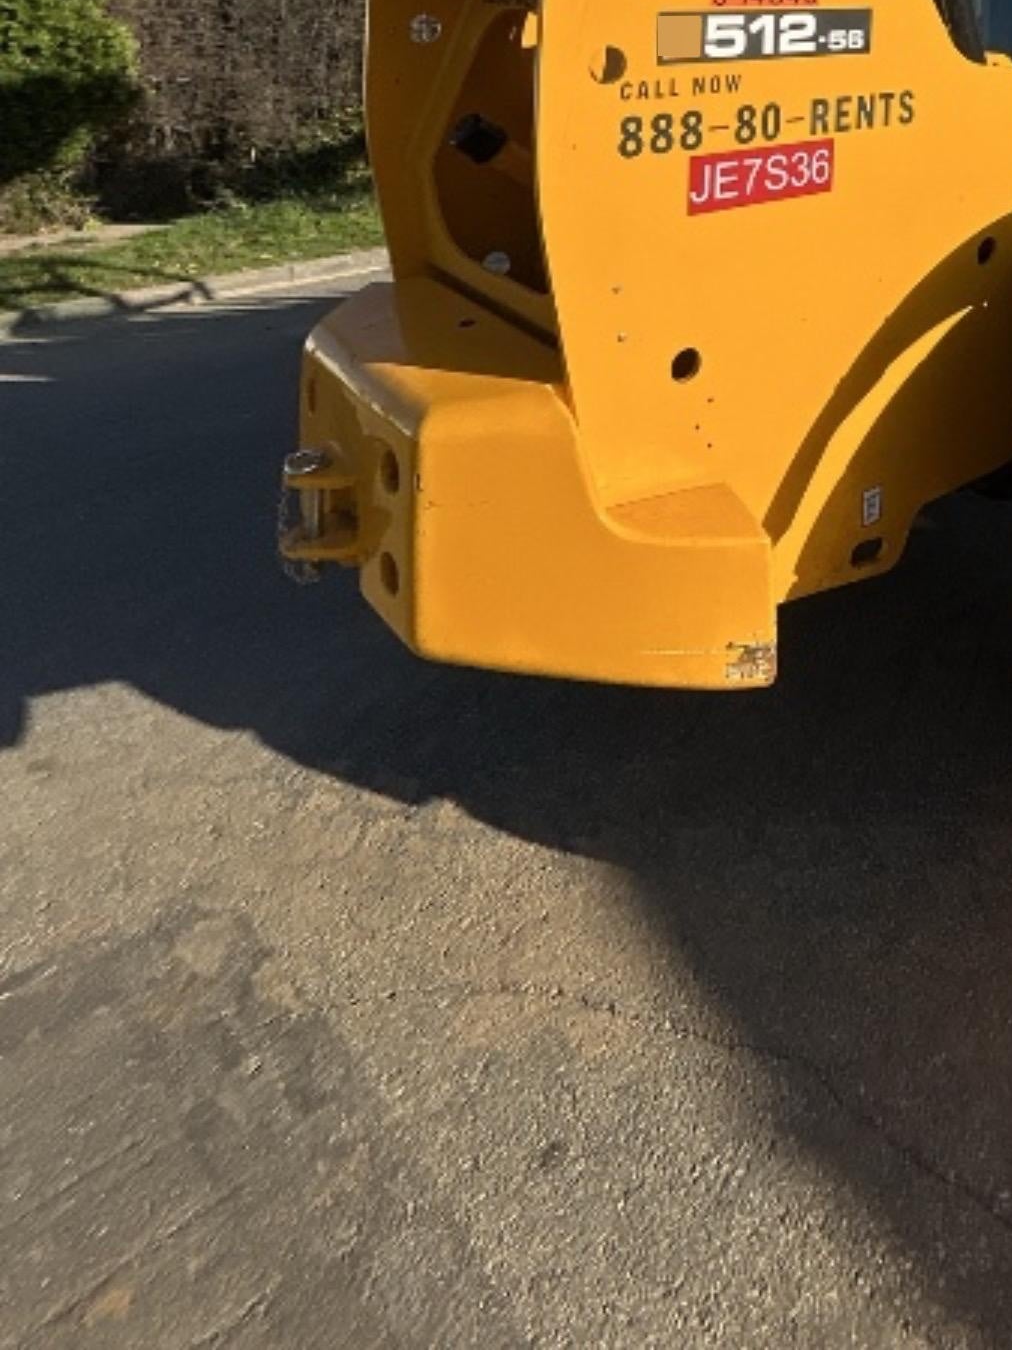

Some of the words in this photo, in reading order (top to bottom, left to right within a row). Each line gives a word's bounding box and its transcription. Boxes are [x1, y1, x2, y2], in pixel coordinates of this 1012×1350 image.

[619, 78, 679, 101] CALL
[692, 74, 742, 96] NOW
[617, 90, 915, 159] 888-80-RENTS
[688, 148, 830, 205] JE7S36
